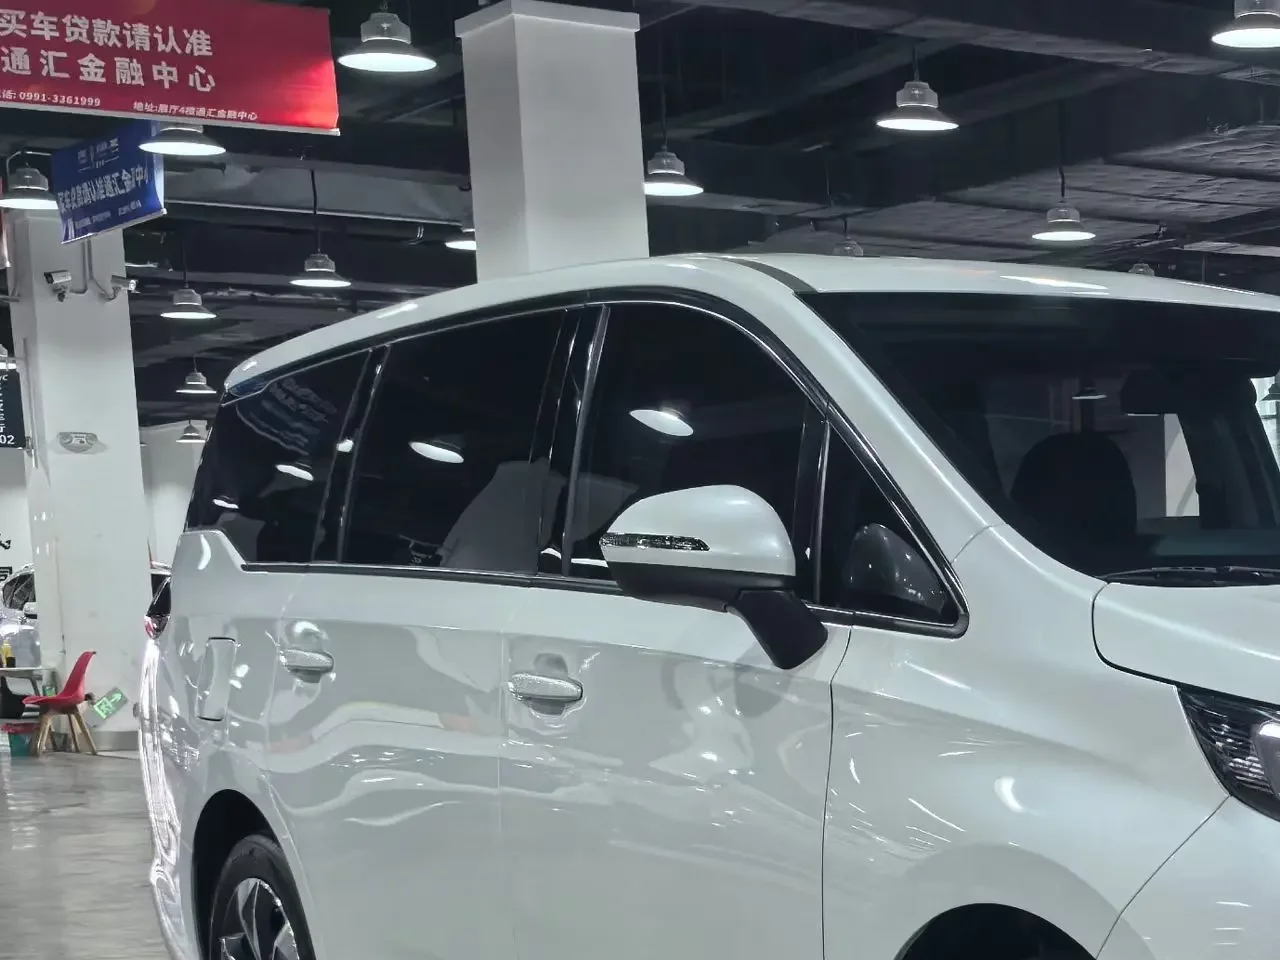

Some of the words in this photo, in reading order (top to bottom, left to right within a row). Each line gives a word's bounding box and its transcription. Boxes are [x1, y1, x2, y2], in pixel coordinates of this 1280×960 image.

[0, 8, 213, 56] 买车贷款请认准
[0, 46, 215, 92] 通汇金融中心
